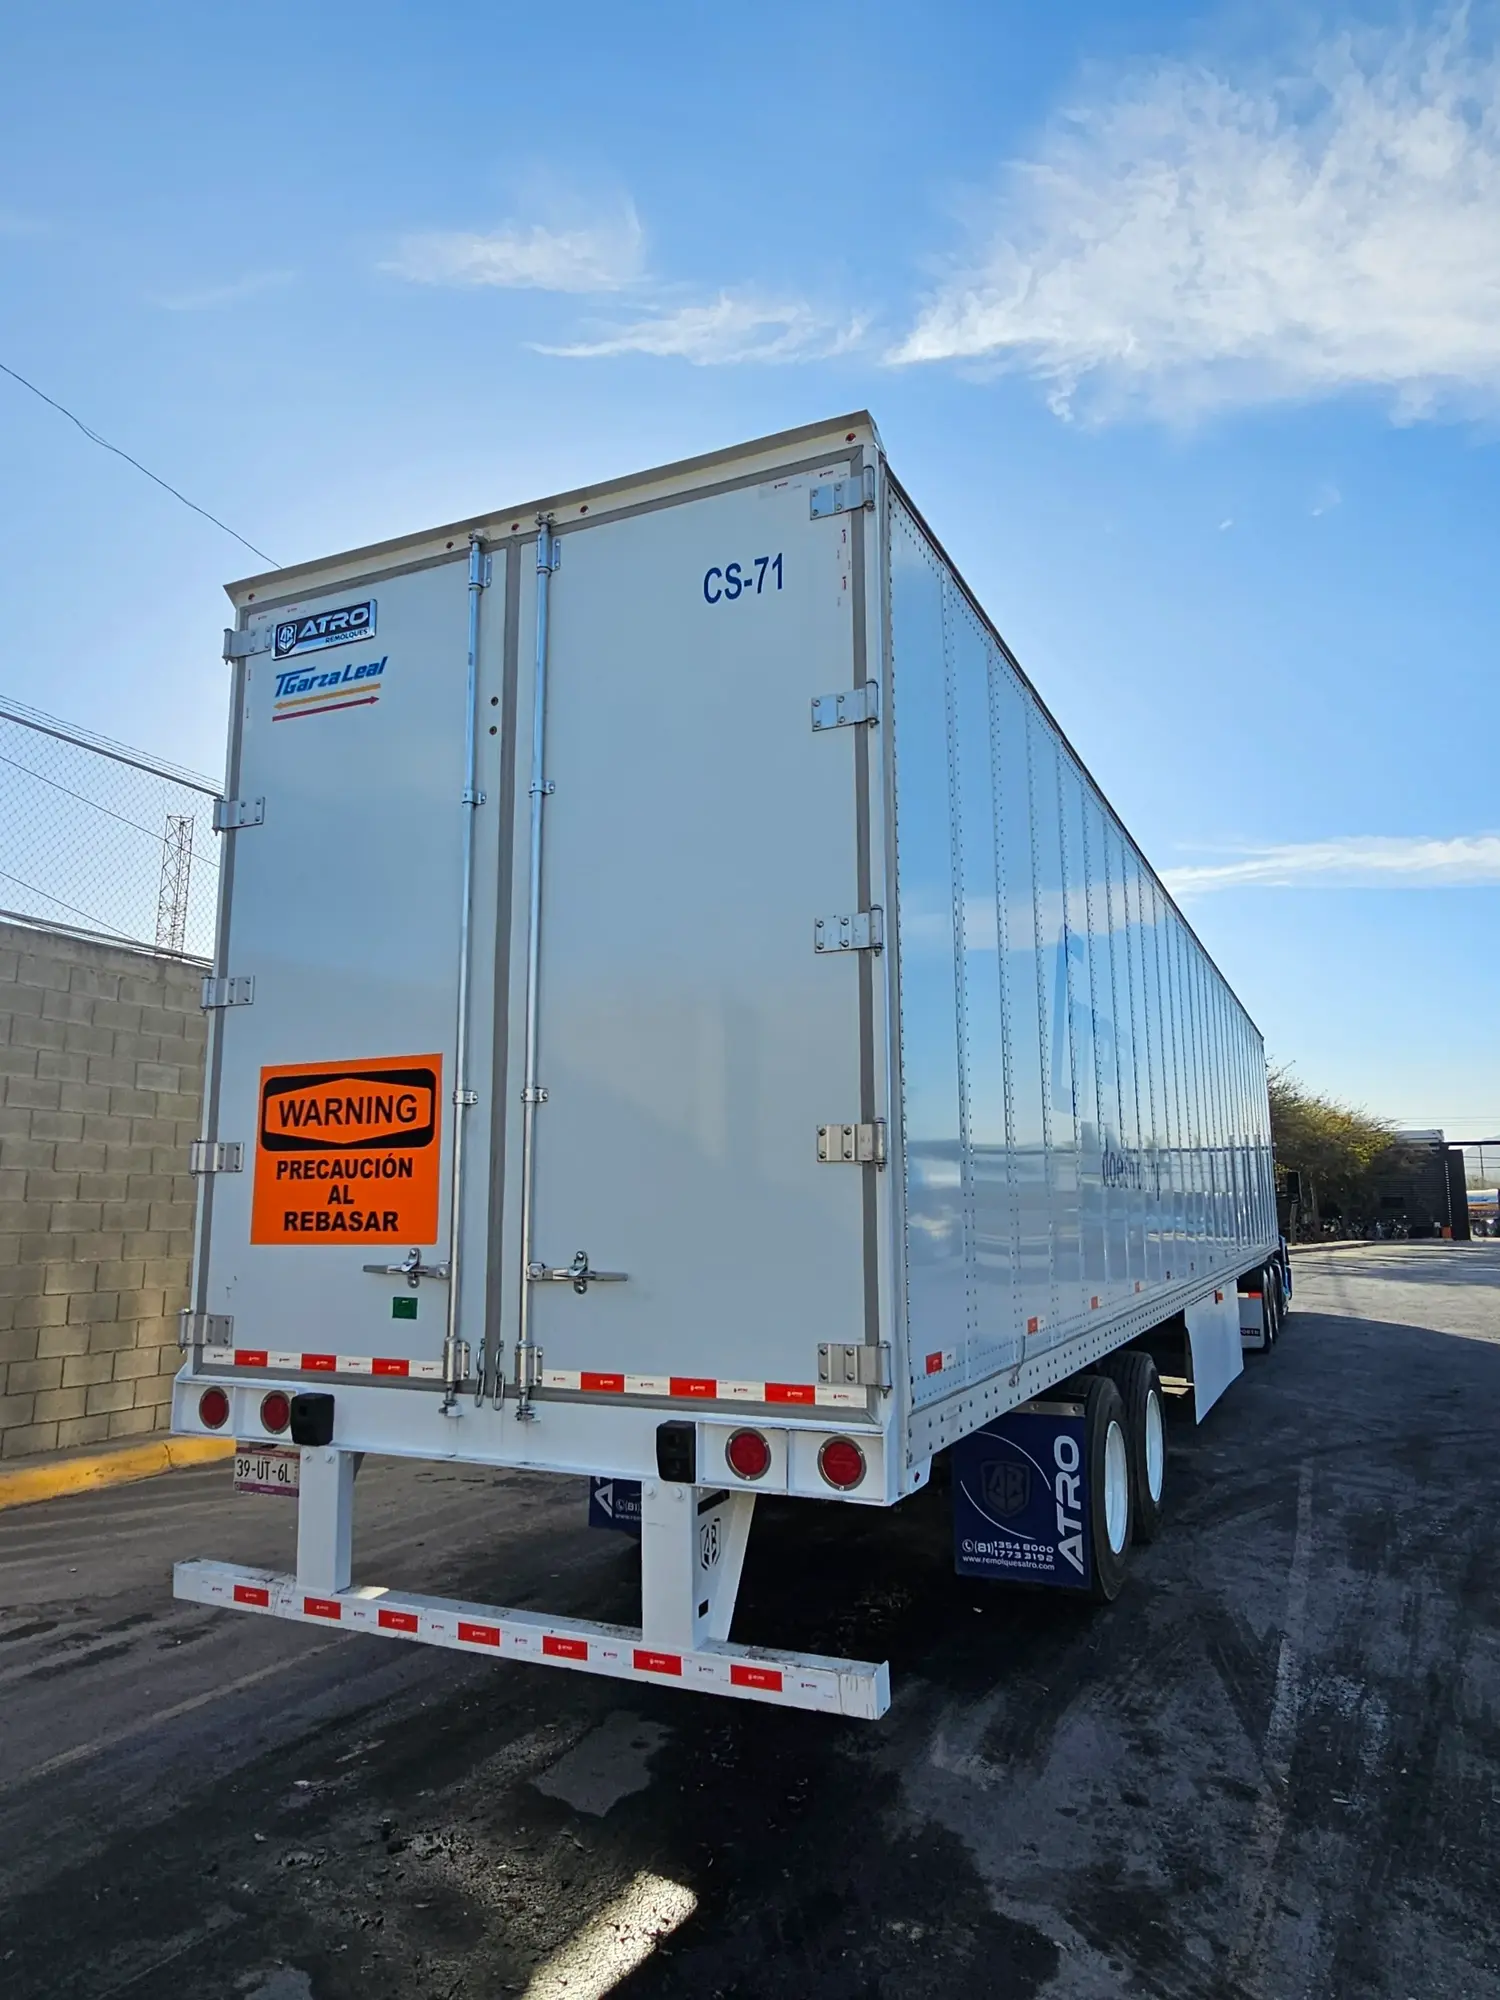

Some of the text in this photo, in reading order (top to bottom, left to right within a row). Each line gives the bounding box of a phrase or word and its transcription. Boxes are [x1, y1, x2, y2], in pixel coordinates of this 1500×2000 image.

[703, 552, 783, 604] CS-71
[298, 607, 369, 639] ATRO
[325, 629, 369, 644] REMOLQUES
[278, 1093, 418, 1128] WARNING
[276, 1153, 413, 1181] PRECAUCIÓN
[327, 1184, 355, 1205] AL
[283, 1211, 400, 1232] REBASAR
[236, 1458, 291, 1483] 39-UT-6L
[1053, 1434, 1084, 1576] ATRO
[974, 1540, 995, 1555] (81)
[962, 1555, 1055, 1571] www.remolquesatro.com
